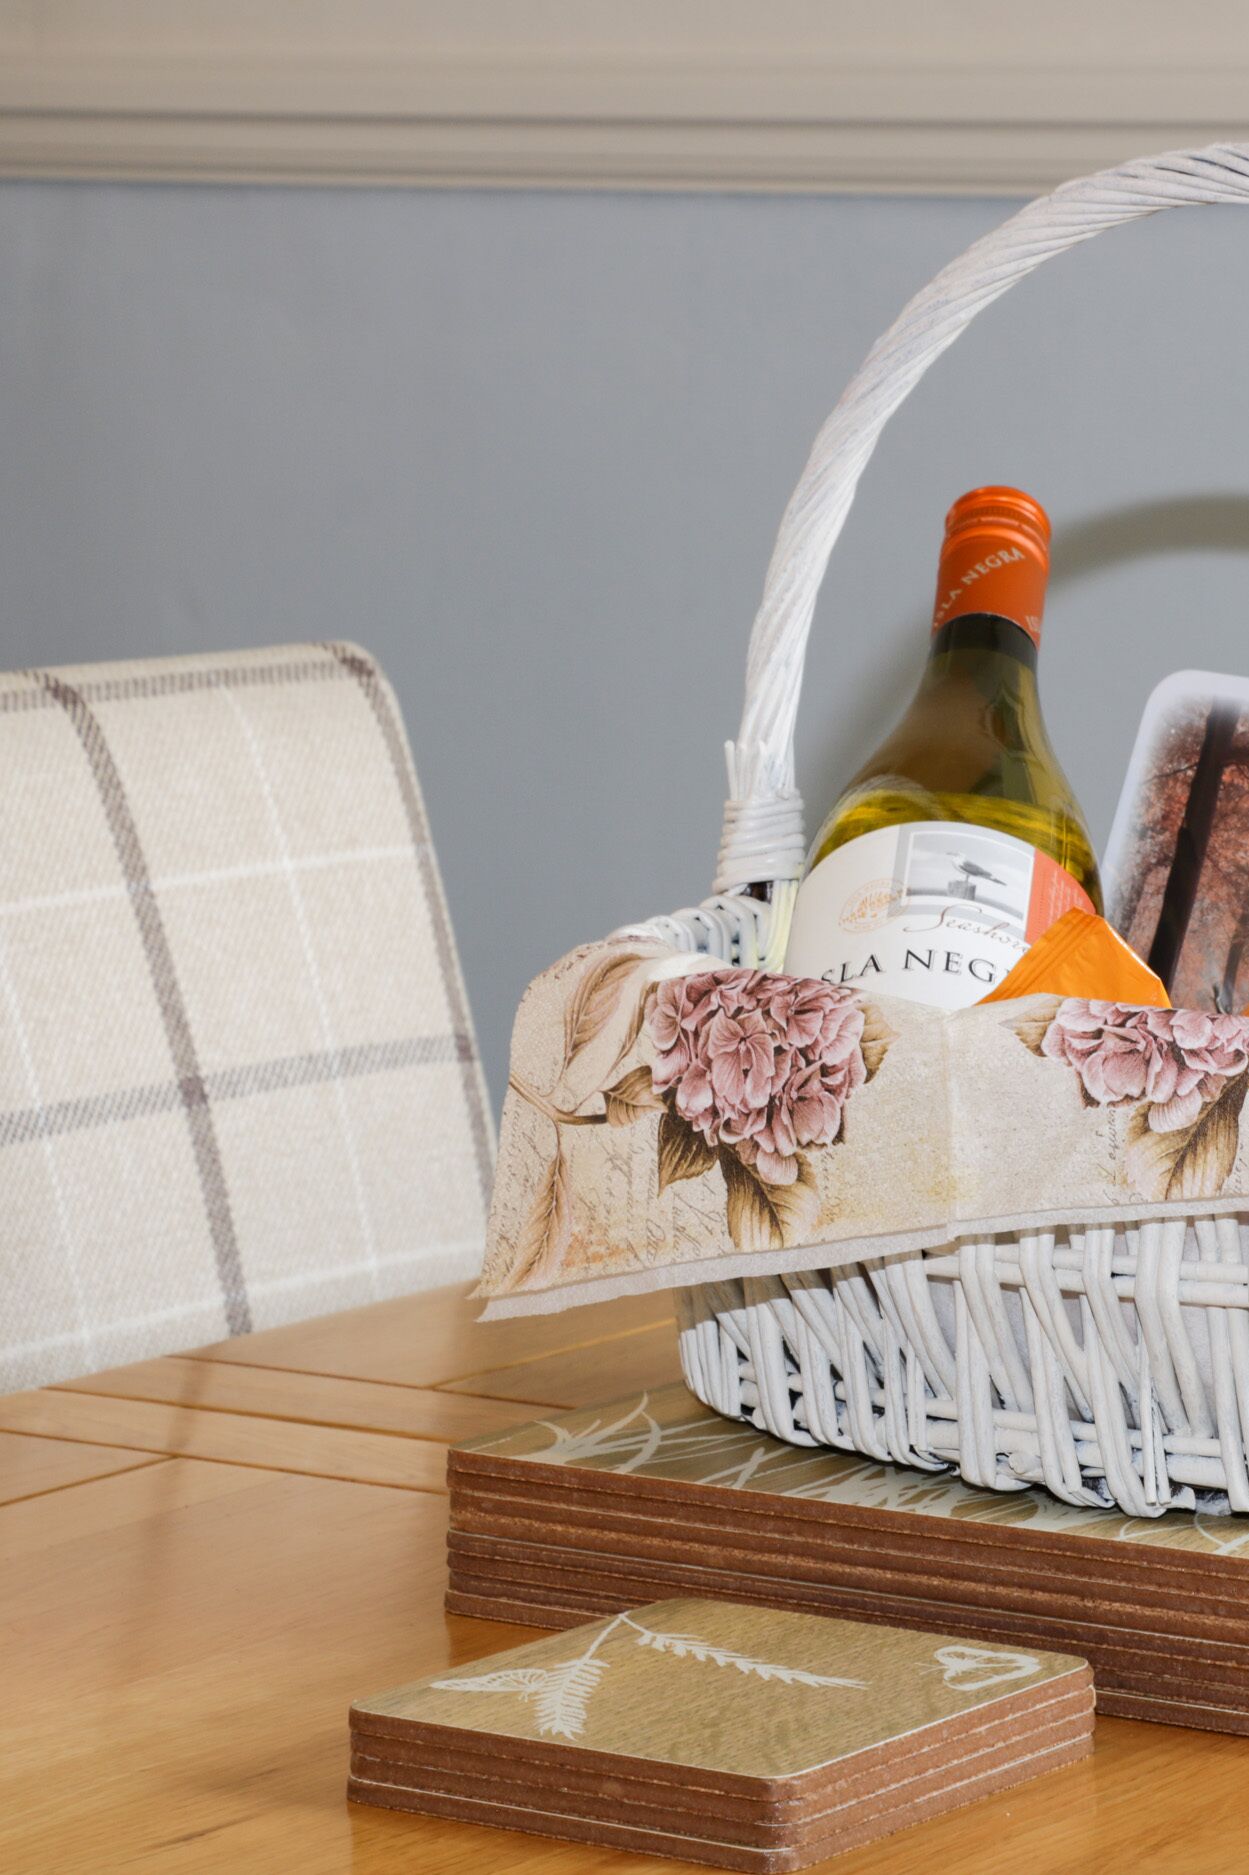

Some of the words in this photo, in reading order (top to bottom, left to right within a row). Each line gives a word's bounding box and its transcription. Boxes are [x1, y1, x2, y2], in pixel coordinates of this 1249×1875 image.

[961, 547, 1025, 585] NEGRA
[820, 954, 886, 985] SLA
[901, 948, 1010, 985] NEG
